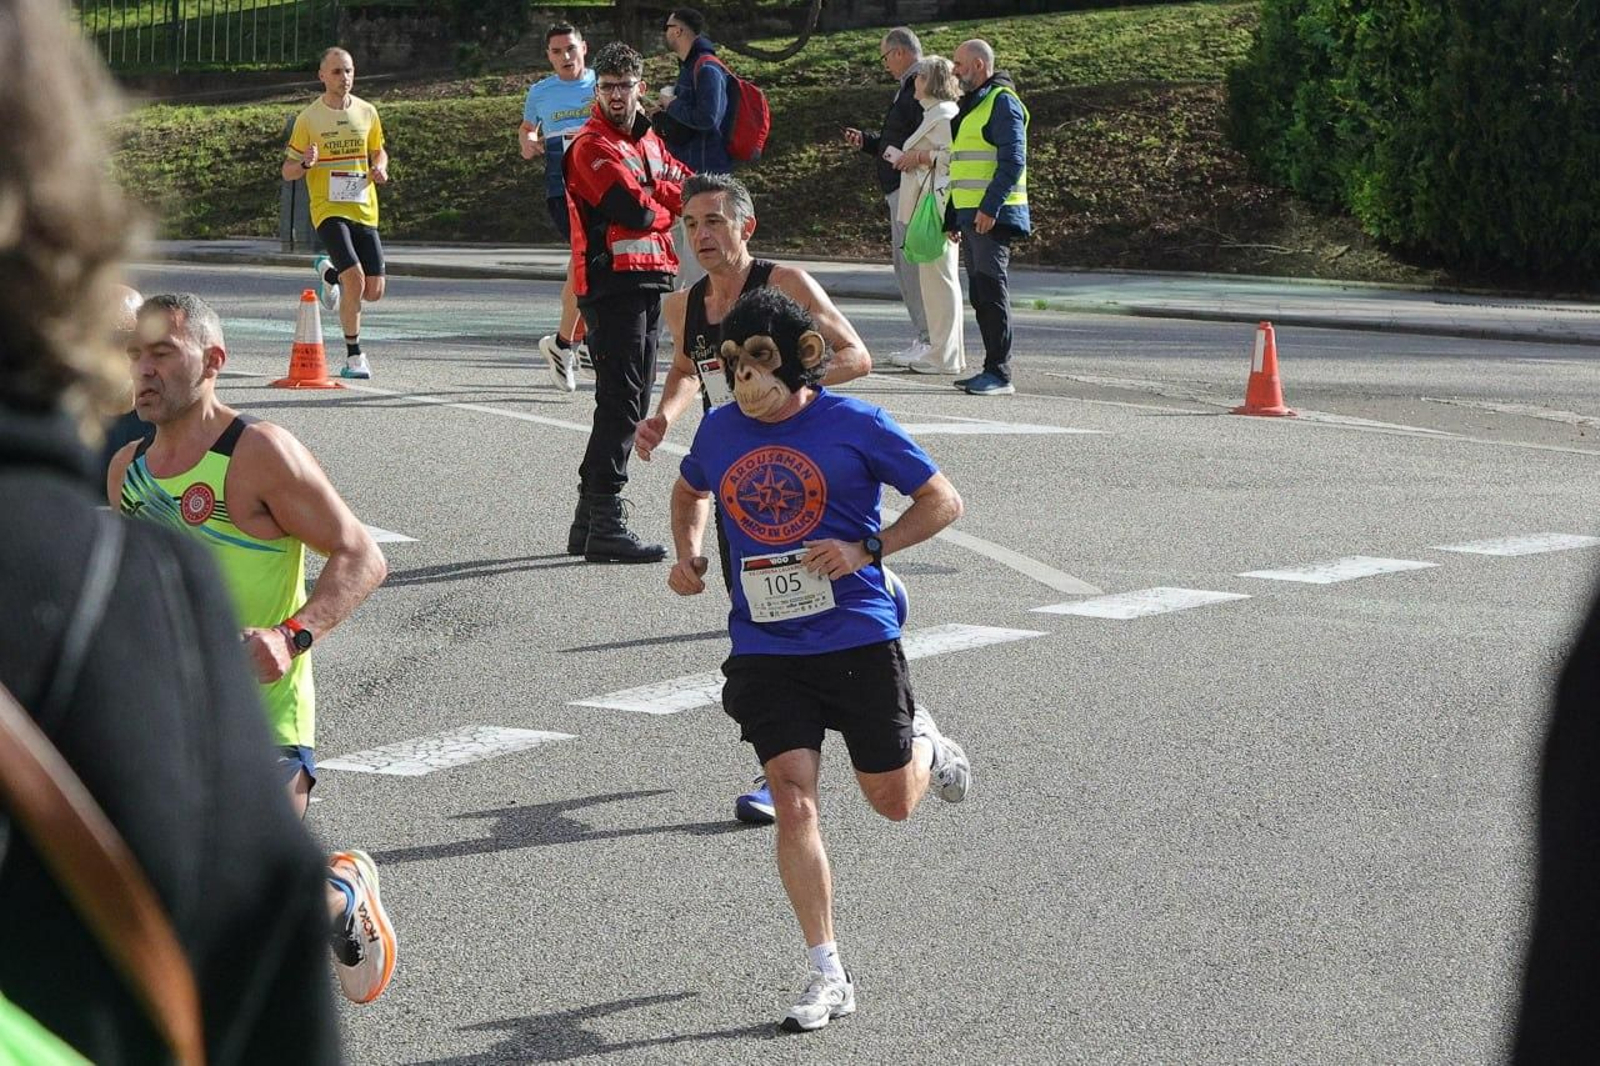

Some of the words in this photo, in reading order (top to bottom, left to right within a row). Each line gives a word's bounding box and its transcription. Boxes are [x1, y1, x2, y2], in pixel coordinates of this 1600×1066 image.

[345, 181, 357, 191] 73
[730, 453, 812, 484] AROUSAMAN
[764, 572, 802, 596] 105
[358, 901, 380, 943] HOKA
